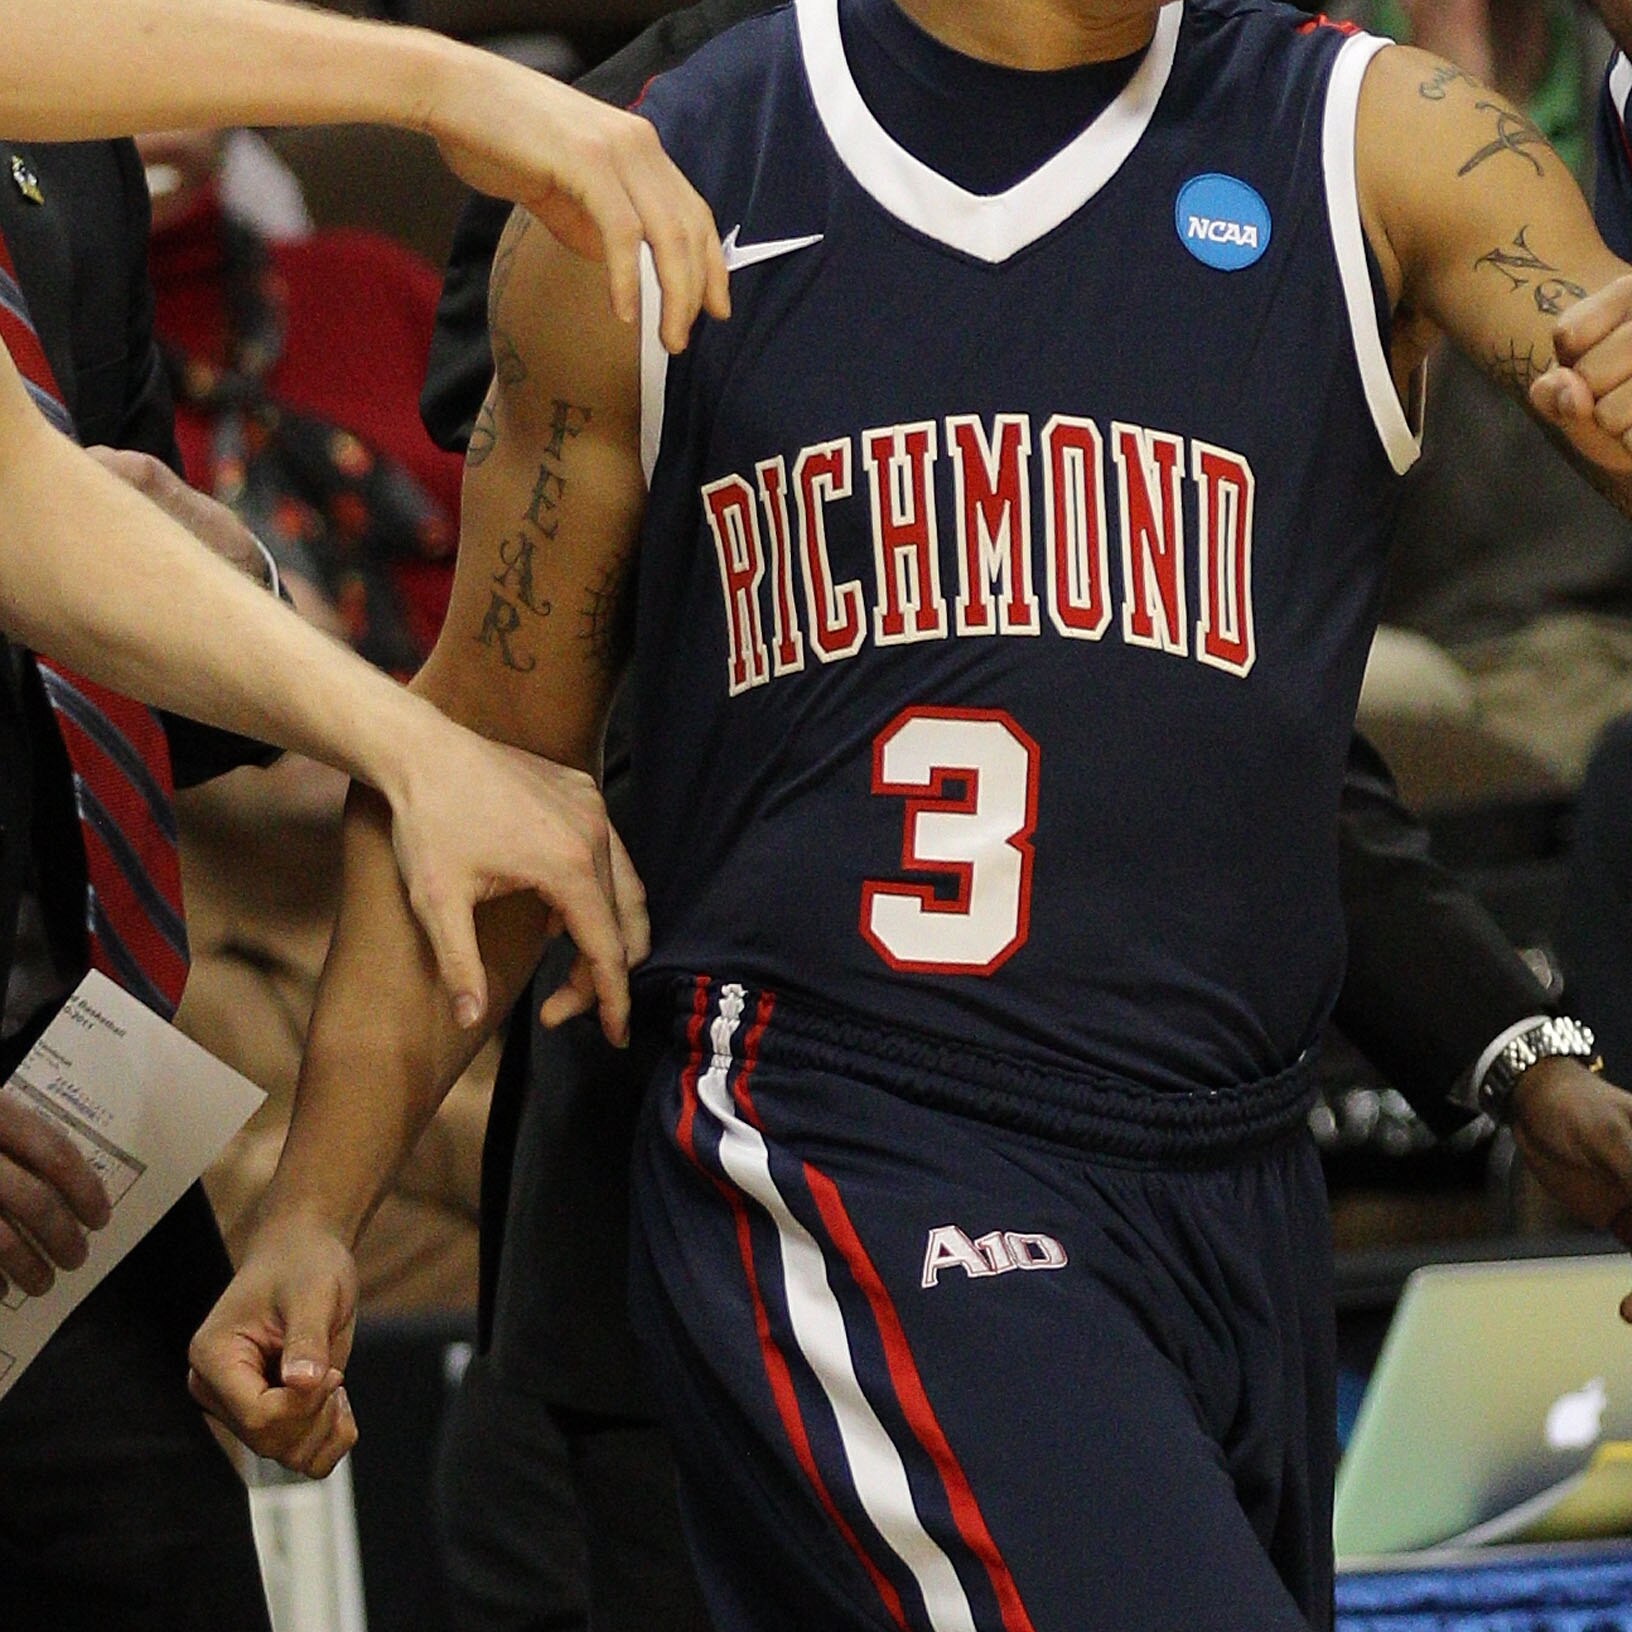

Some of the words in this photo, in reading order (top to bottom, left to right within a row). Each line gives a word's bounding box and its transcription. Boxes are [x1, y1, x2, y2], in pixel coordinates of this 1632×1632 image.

[1186, 216, 1260, 249] NCAA
[701, 413, 1257, 697] RICHMOND
[859, 705, 1041, 977] 3
[921, 1225, 1068, 1289] A10
